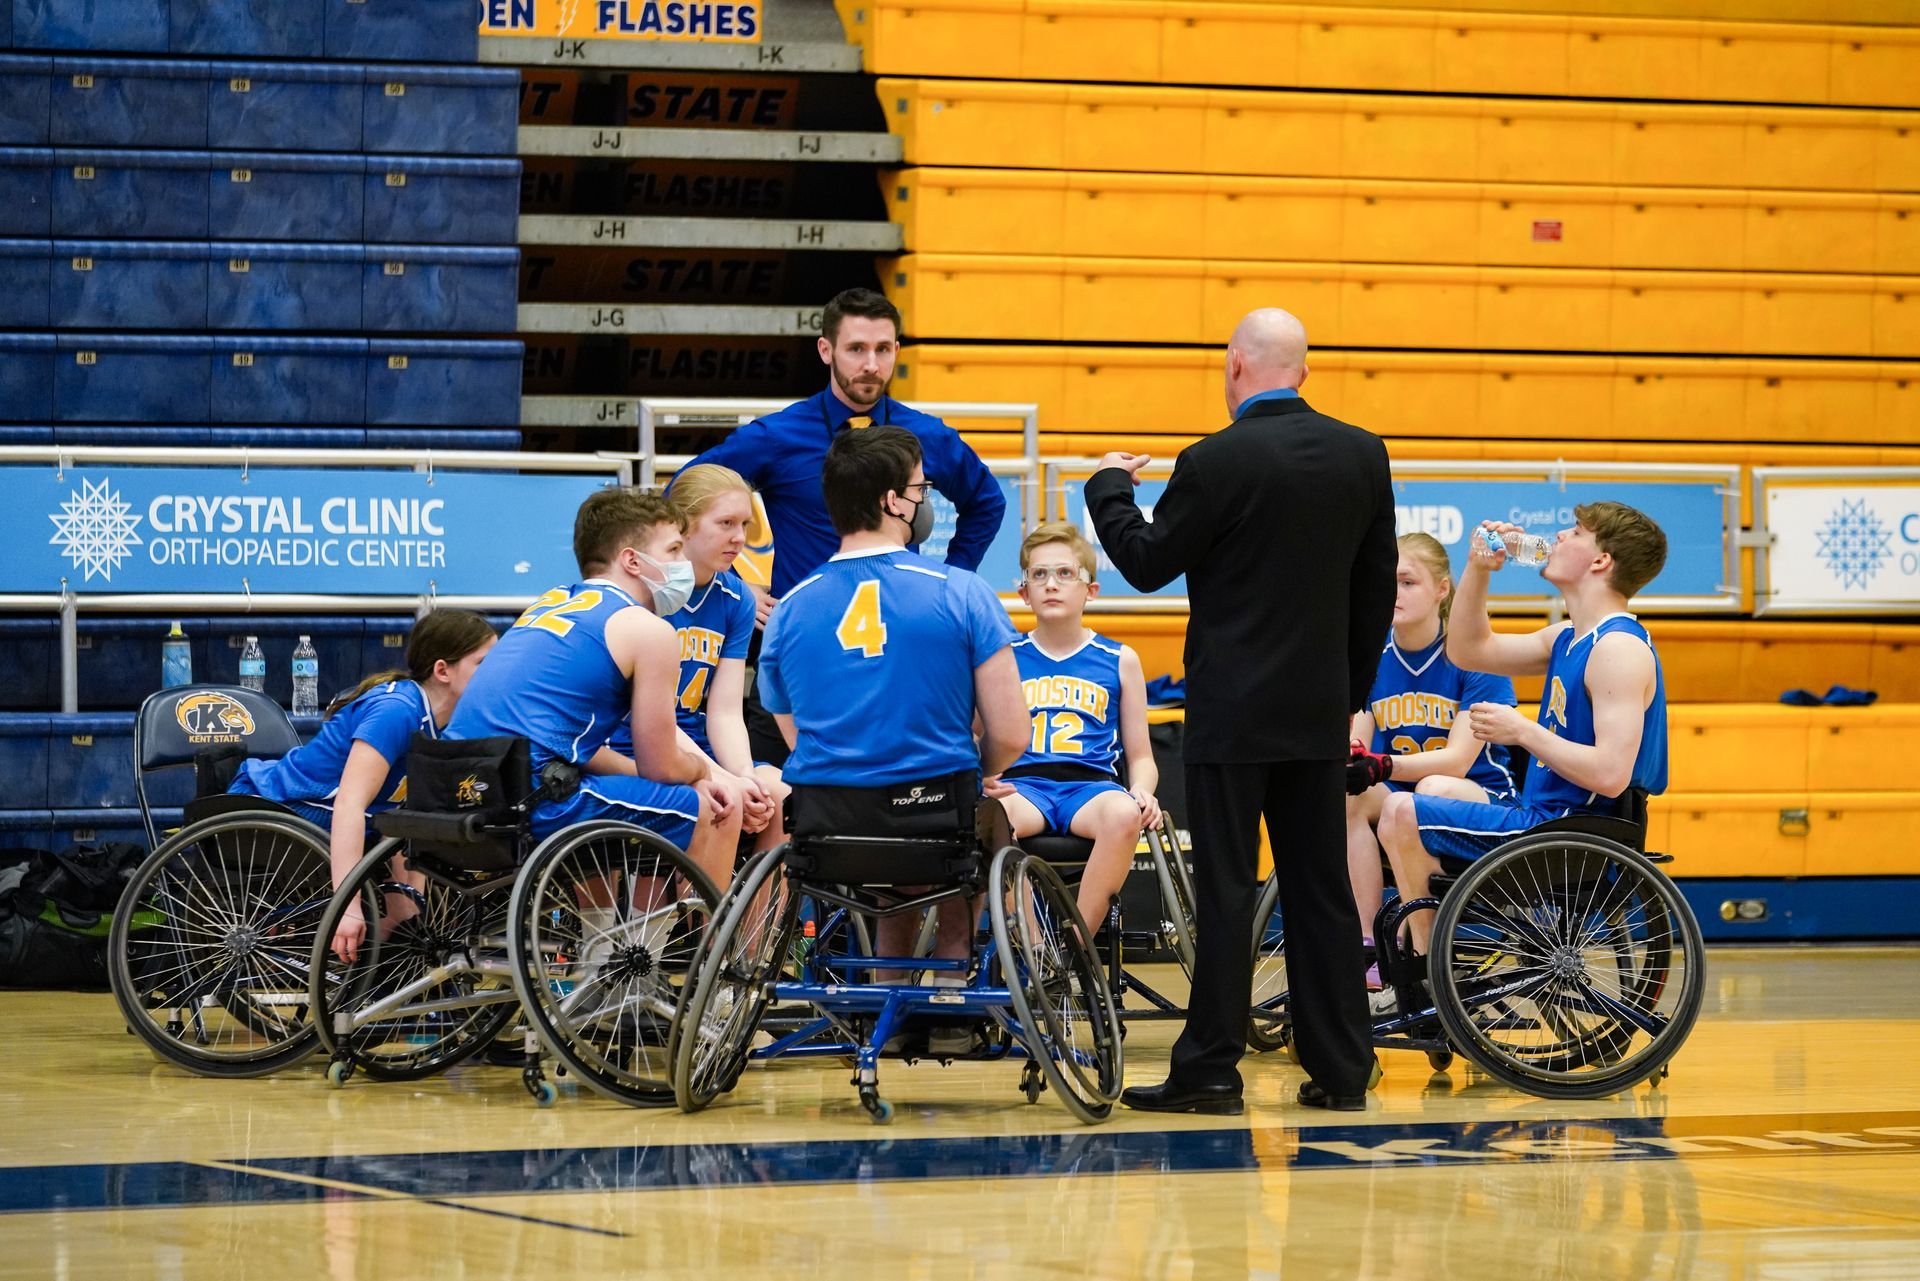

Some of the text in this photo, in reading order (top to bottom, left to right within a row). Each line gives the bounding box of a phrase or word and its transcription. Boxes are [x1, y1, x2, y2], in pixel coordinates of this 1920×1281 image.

[479, 0, 757, 37] EN FLASHES
[554, 41, 586, 60] J-K
[758, 46, 784, 65] I-K
[629, 85, 787, 126] STATE
[593, 131, 622, 150] J-J
[799, 136, 821, 155] I-J
[623, 173, 785, 210] FLASHES
[593, 221, 626, 240] J-H
[798, 225, 825, 245] I-H
[623, 258, 780, 296] STATE
[591, 307, 625, 328] J-G
[629, 349, 789, 381] FLASHES
[596, 402, 627, 422] J-F
[147, 495, 445, 536] CRYSTAL CLINIC
[1395, 505, 1464, 545] NED
[148, 537, 446, 568] ORTHOPAEDIC CENTER
[512, 588, 603, 638] 22
[835, 579, 888, 659] 4
[1021, 675, 1110, 725] OOSTER
[197, 703, 231, 735] K
[1031, 710, 1085, 755] 12
[189, 735, 240, 743] KENT STATE
[892, 794, 945, 806] TOP END
